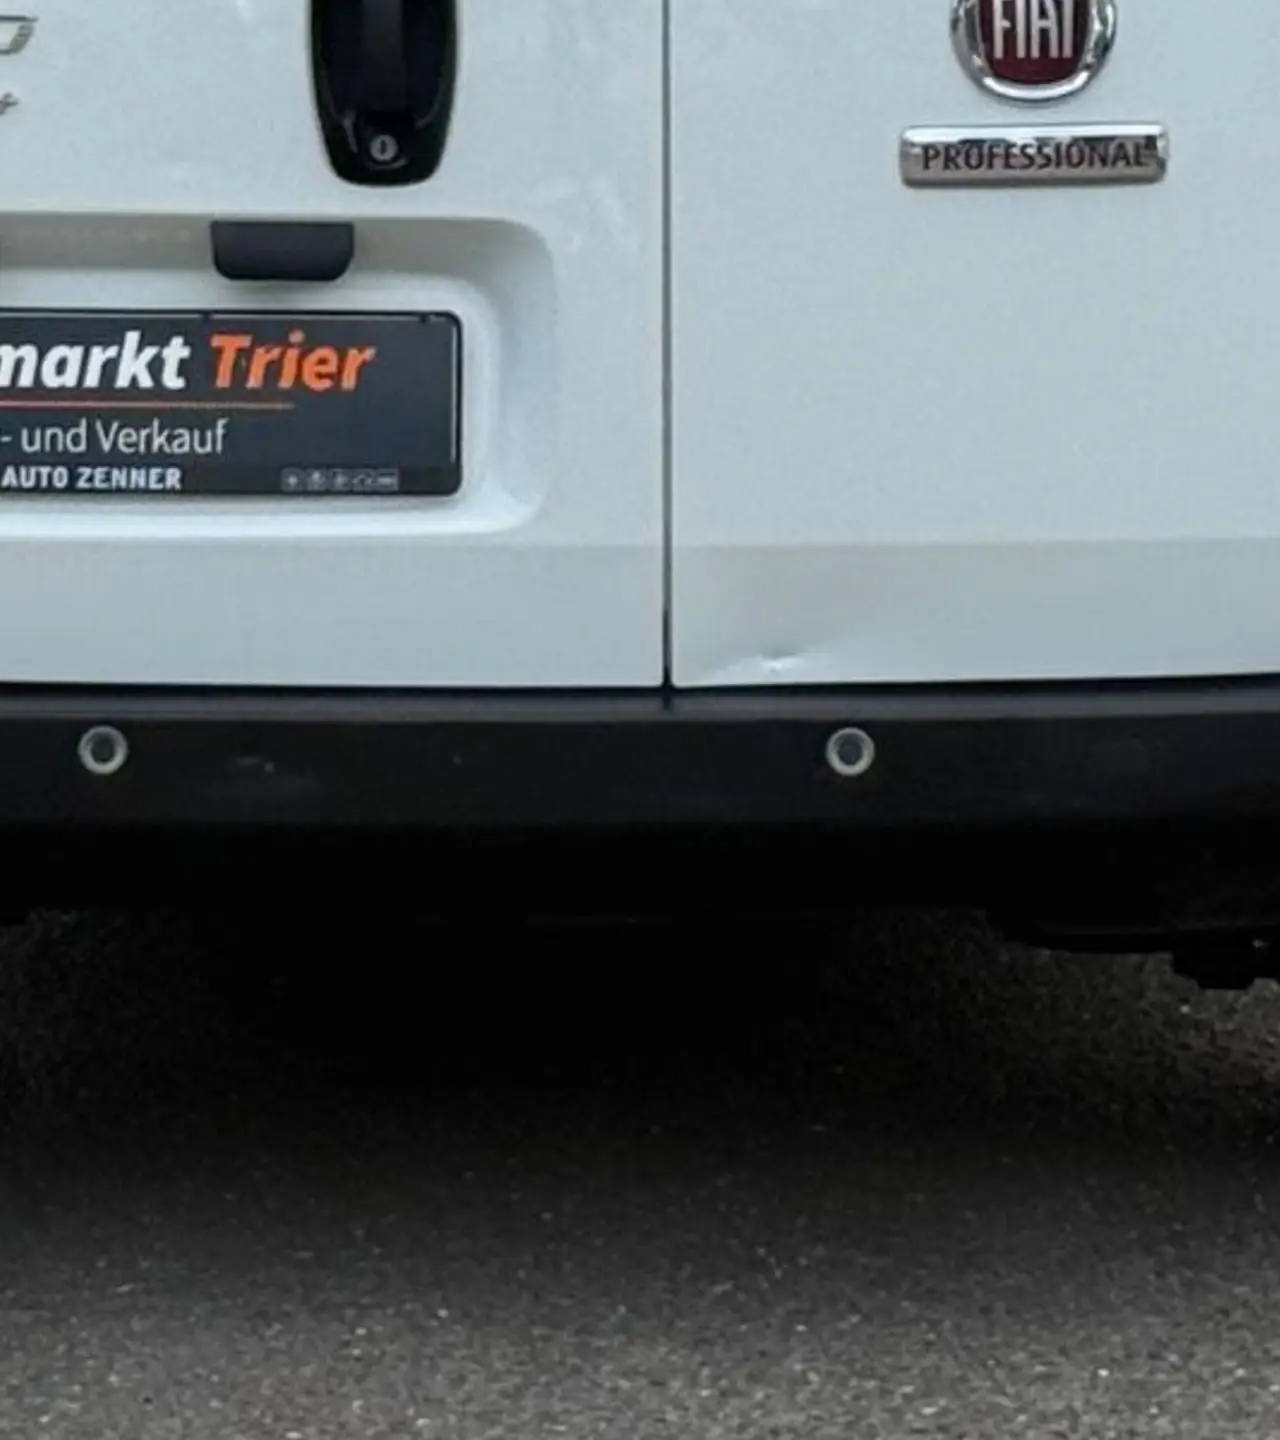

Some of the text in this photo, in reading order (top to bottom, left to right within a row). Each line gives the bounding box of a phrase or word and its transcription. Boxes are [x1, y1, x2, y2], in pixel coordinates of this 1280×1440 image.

[921, 140, 1149, 171] PROFESSIONAL
[210, 330, 376, 392] Trier
[22, 417, 87, 454] und
[94, 417, 230, 455] Verkauf
[1, 466, 182, 491] AUTO ZENNER
